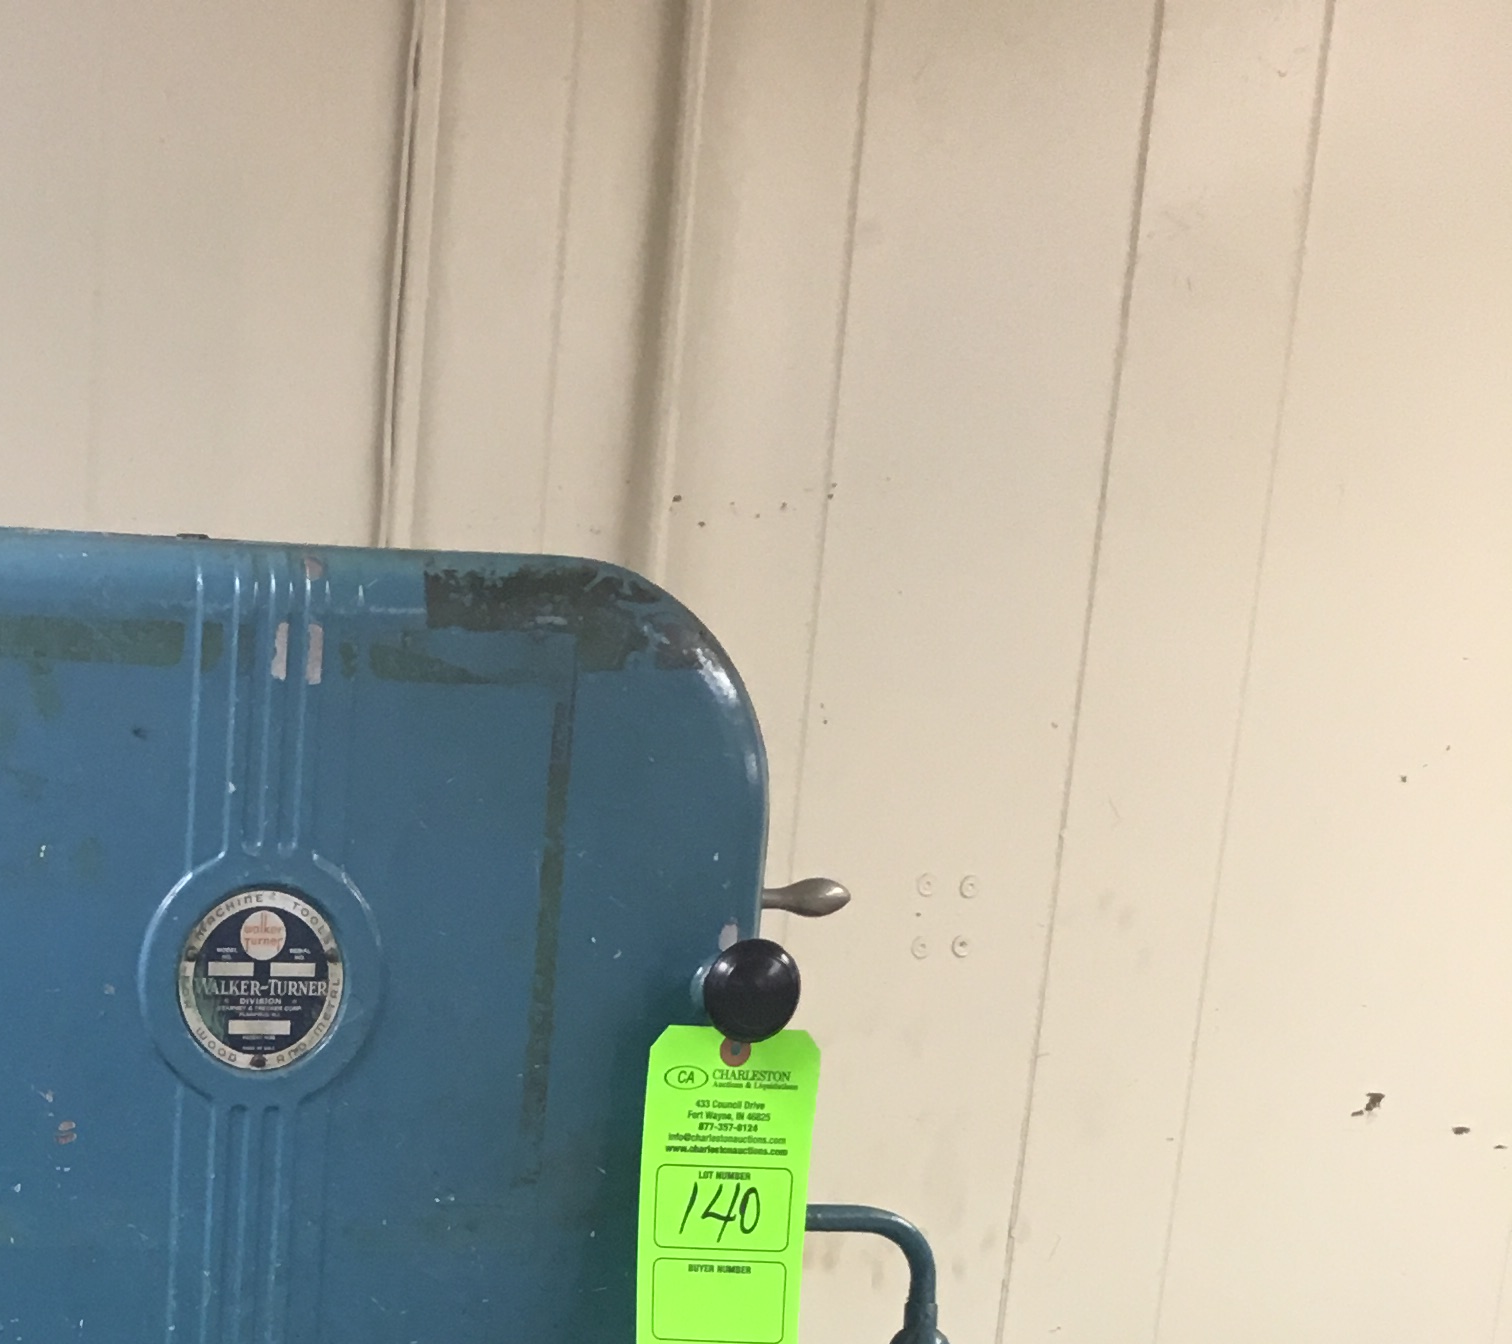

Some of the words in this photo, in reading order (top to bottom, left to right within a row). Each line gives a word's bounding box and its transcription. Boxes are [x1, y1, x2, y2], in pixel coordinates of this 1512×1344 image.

[194, 978, 328, 996] WALKER-TURNER
[678, 1071, 694, 1083] CA
[713, 1069, 792, 1082] CHARLESTON
[712, 1100, 742, 1109] Council
[744, 1101, 765, 1109] Drive
[688, 1110, 703, 1119] Fort
[705, 1111, 733, 1121] Wayne,
[736, 1112, 744, 1120] IN
[699, 1171, 713, 1179] LOT
[716, 1172, 751, 1180] NUMBER
[679, 1182, 760, 1243] 140
[688, 1264, 714, 1272] BUYER
[717, 1264, 751, 1274] NUMBER
